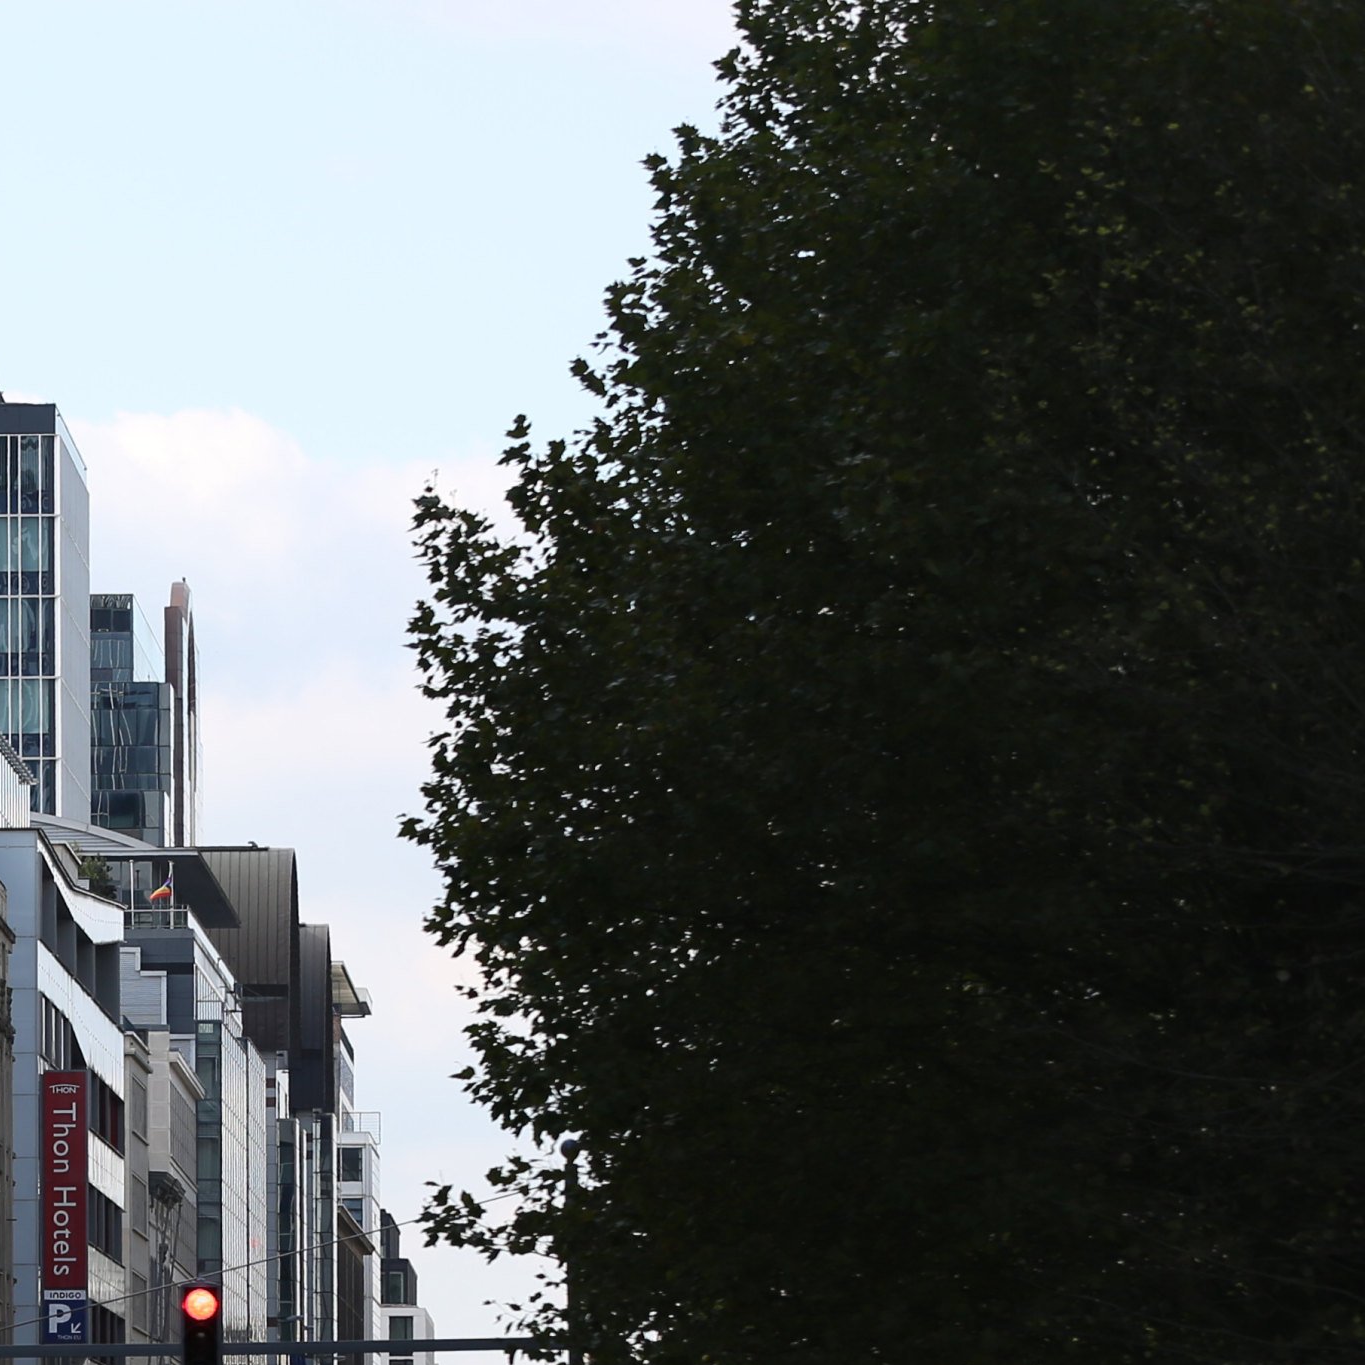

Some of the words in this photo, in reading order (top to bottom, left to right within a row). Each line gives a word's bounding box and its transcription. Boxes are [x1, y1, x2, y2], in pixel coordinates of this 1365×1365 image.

[48, 1083, 80, 1094] THON
[53, 1102, 77, 1173] Thon
[53, 1187, 77, 1276] Hotels
[49, 1291, 82, 1299] INDIGO
[48, 1303, 72, 1334] P
